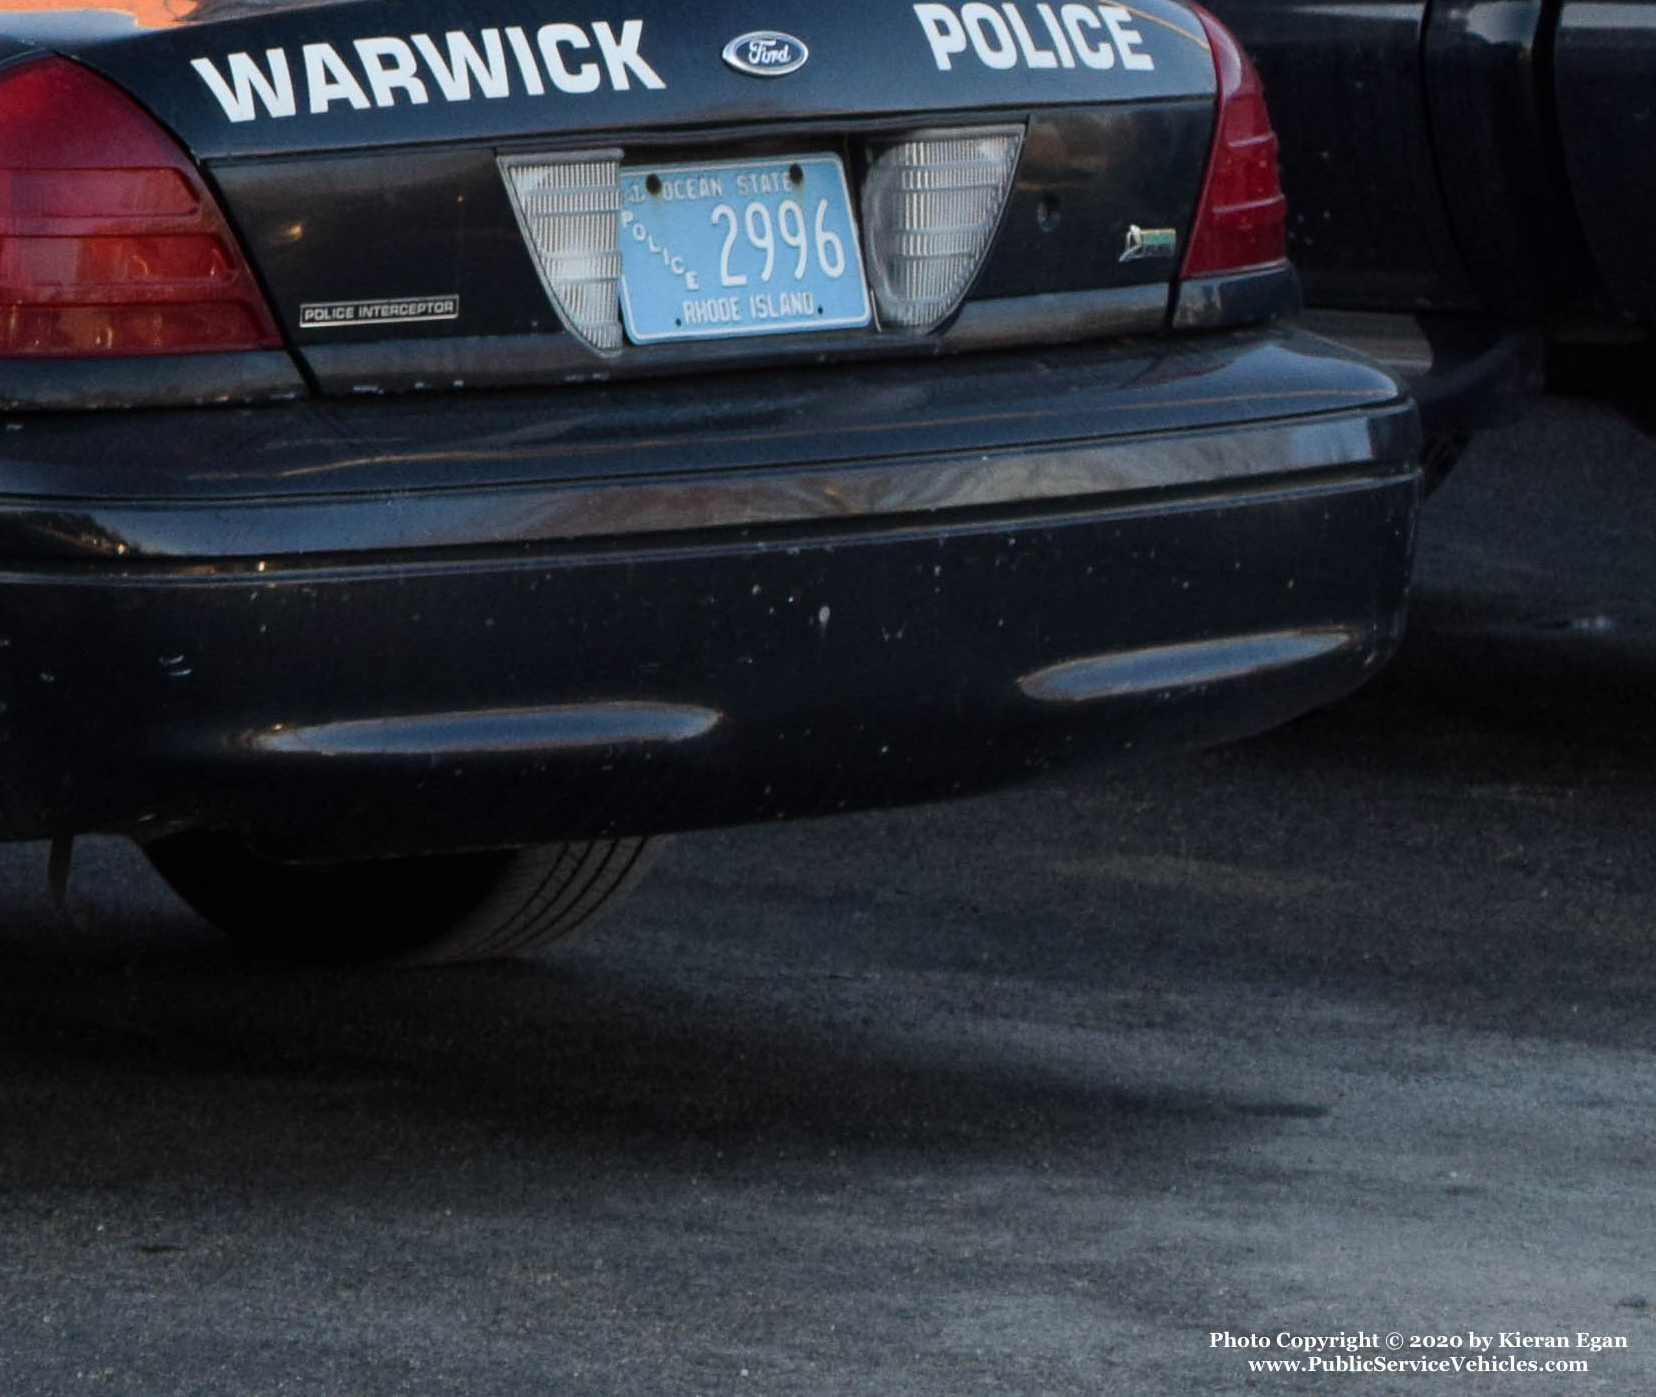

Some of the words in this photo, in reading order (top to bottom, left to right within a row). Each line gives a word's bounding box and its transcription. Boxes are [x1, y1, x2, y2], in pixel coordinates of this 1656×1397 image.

[189, 19, 667, 123] WARWICK
[913, 2, 1156, 71] POLICE
[660, 177, 723, 203] OCEAN
[736, 171, 793, 196] STATE
[621, 209, 700, 291] POLICE
[710, 199, 846, 287] 2996
[305, 308, 354, 321] POLICE
[358, 300, 454, 318] INTERCEPTOR
[682, 296, 742, 324] RHODE
[749, 292, 814, 318] ISLAND
